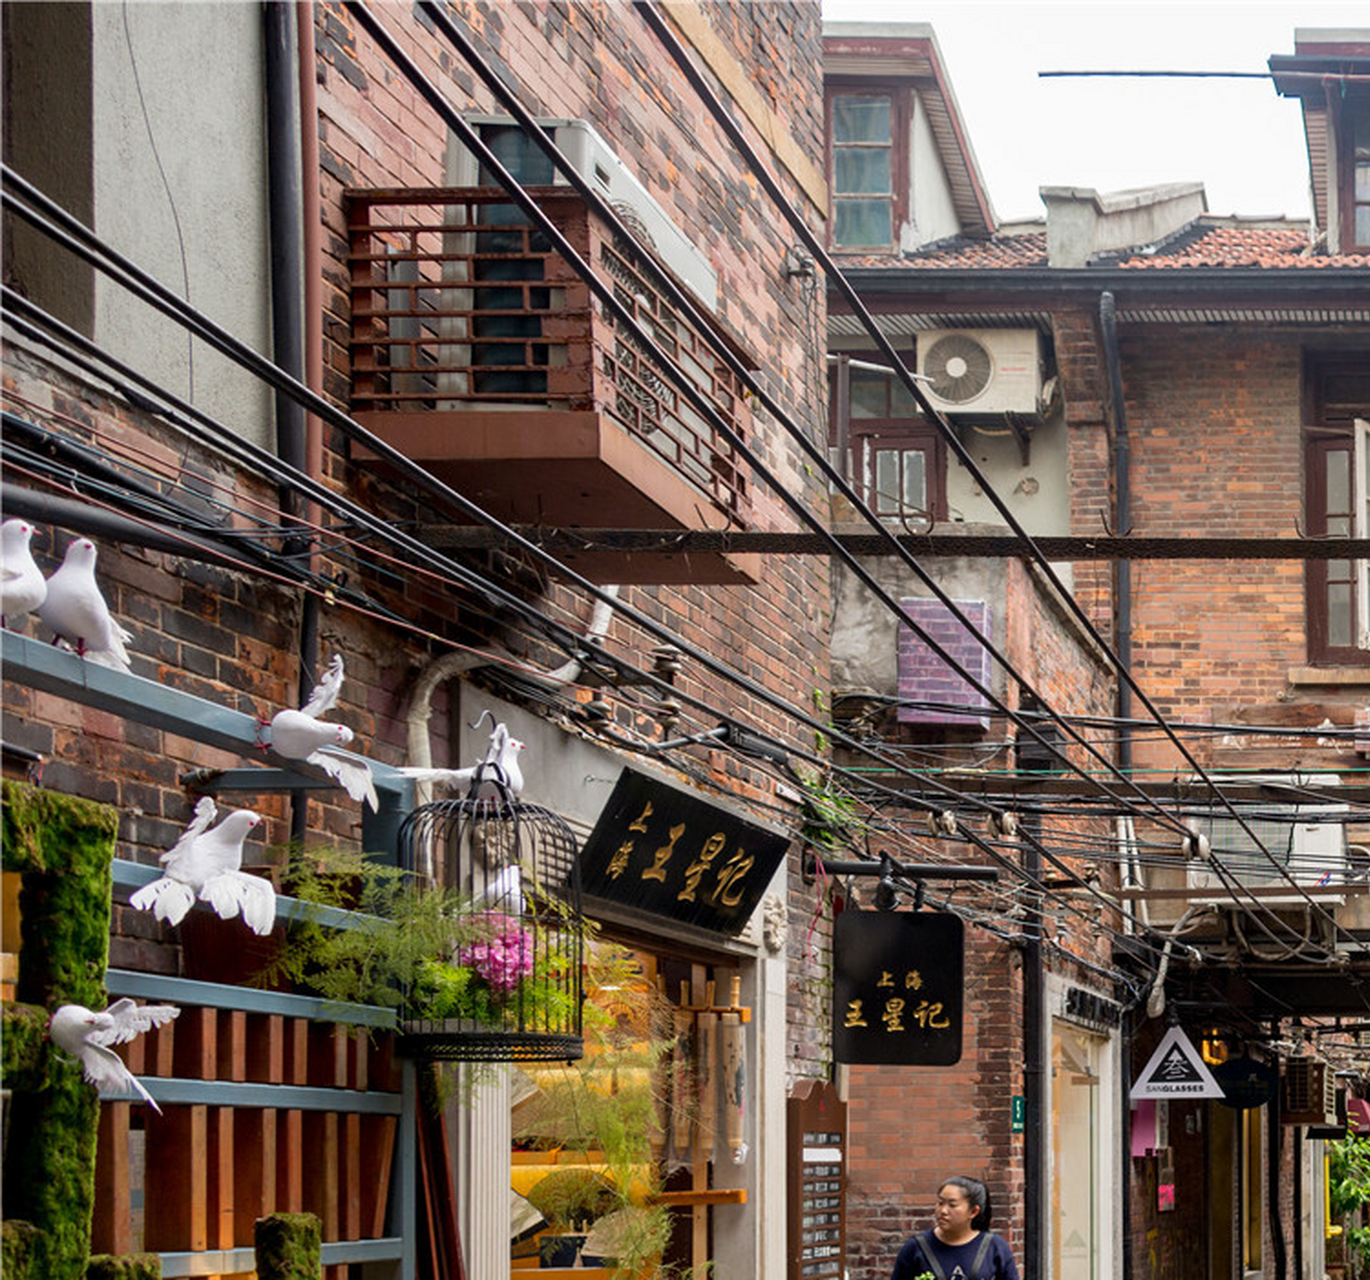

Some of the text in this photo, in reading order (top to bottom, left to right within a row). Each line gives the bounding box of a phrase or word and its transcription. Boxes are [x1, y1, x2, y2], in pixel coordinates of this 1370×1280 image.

[876, 969, 924, 990] 上海
[842, 998, 951, 1033] 王星记
